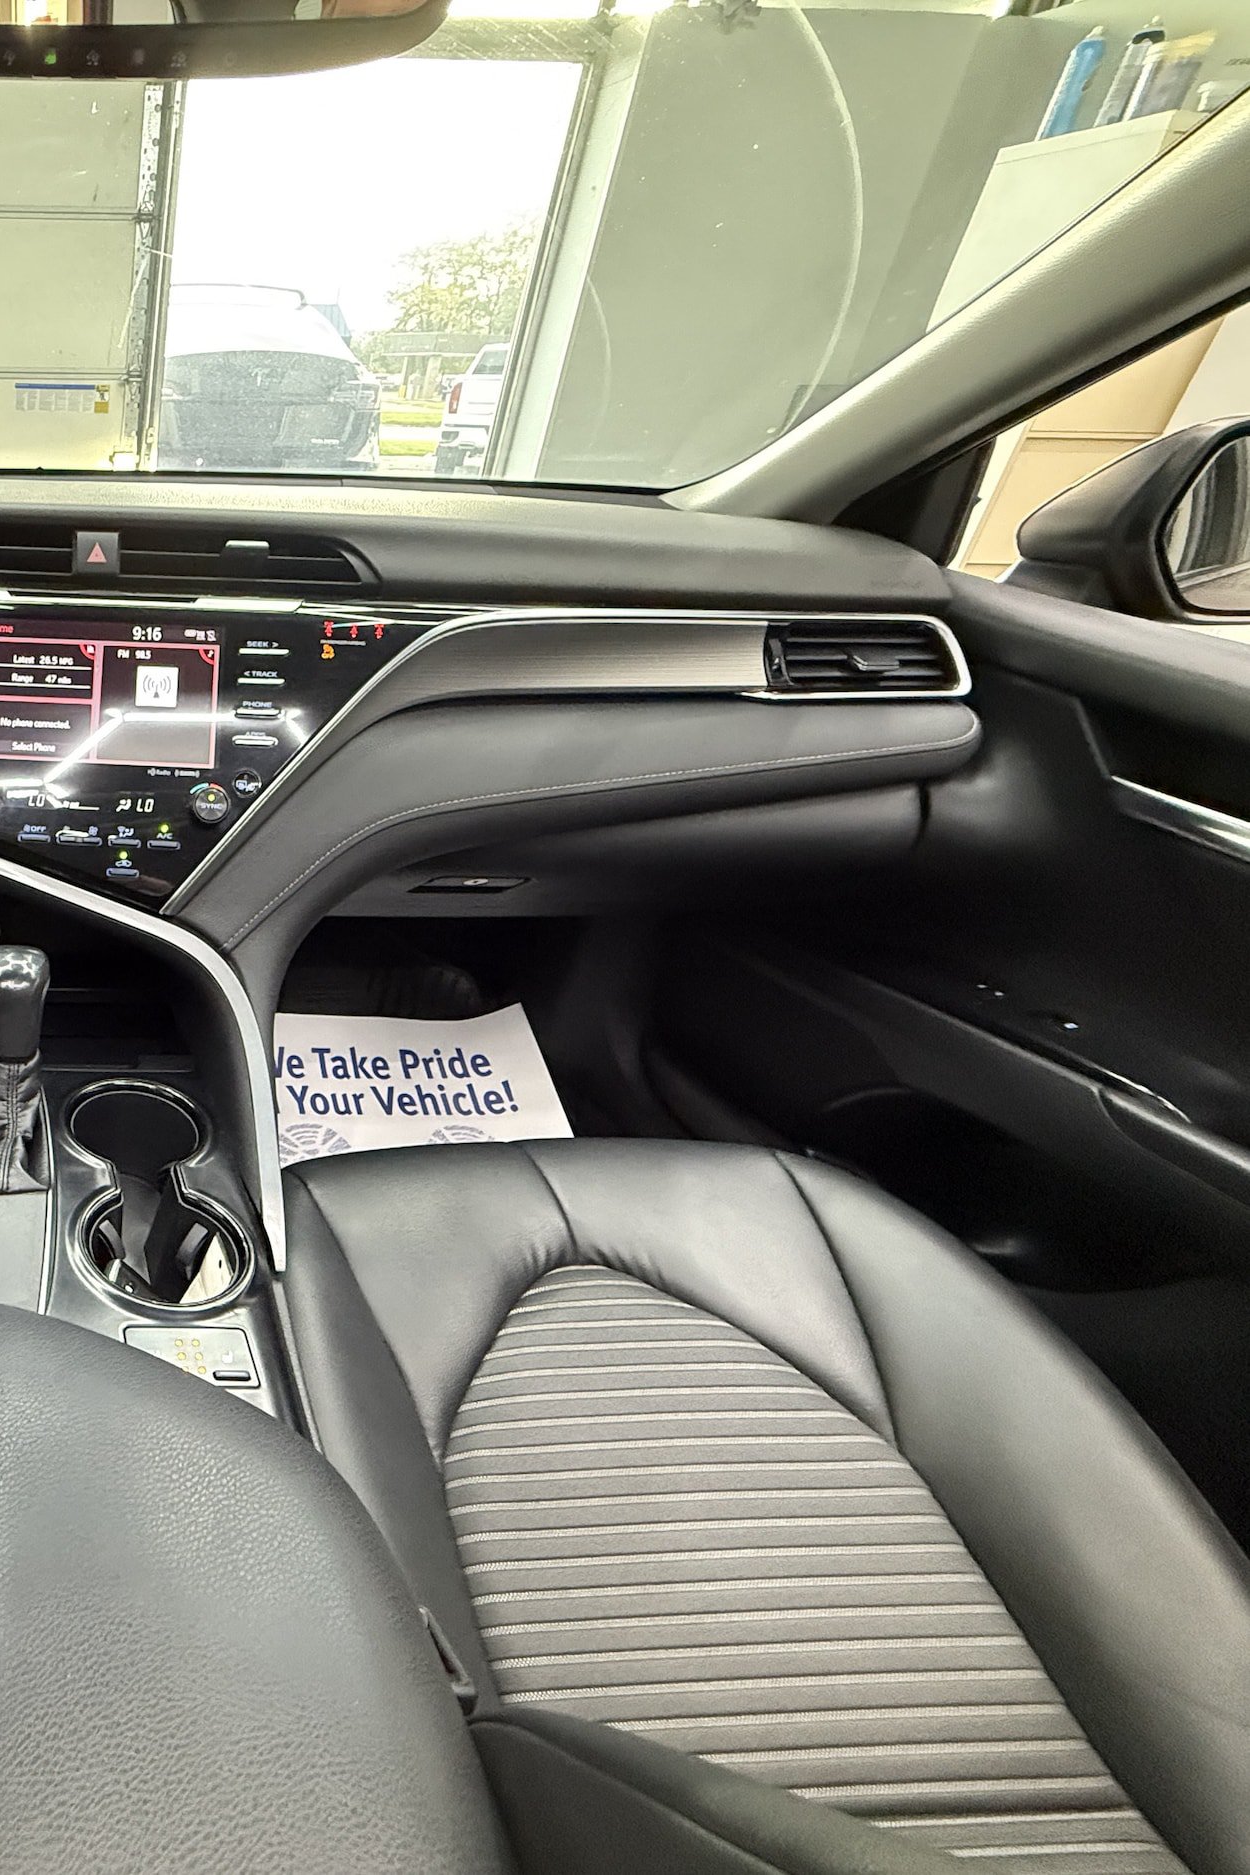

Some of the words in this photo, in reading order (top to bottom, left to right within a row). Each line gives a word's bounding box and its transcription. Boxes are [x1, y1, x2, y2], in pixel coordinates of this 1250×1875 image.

[132, 626, 162, 641] 9:16
[246, 640, 269, 648] SEEK
[117, 648, 130, 659] FM
[11, 672, 34, 684] Range
[44, 674, 58, 684] 47
[251, 670, 279, 678] TRACK
[242, 700, 273, 709] PHONE
[0, 717, 12, 727] No
[11, 718, 33, 729] phone
[33, 719, 71, 730] connected.
[11, 741, 33, 752] Select
[33, 741, 56, 753] Phone
[199, 801, 224, 810] SYNC
[156, 832, 174, 840] A/C
[310, 1046, 391, 1080] Take
[398, 1047, 493, 1080] Pride
[285, 1084, 365, 1116] Your
[370, 1079, 519, 1117] Vehicle!
